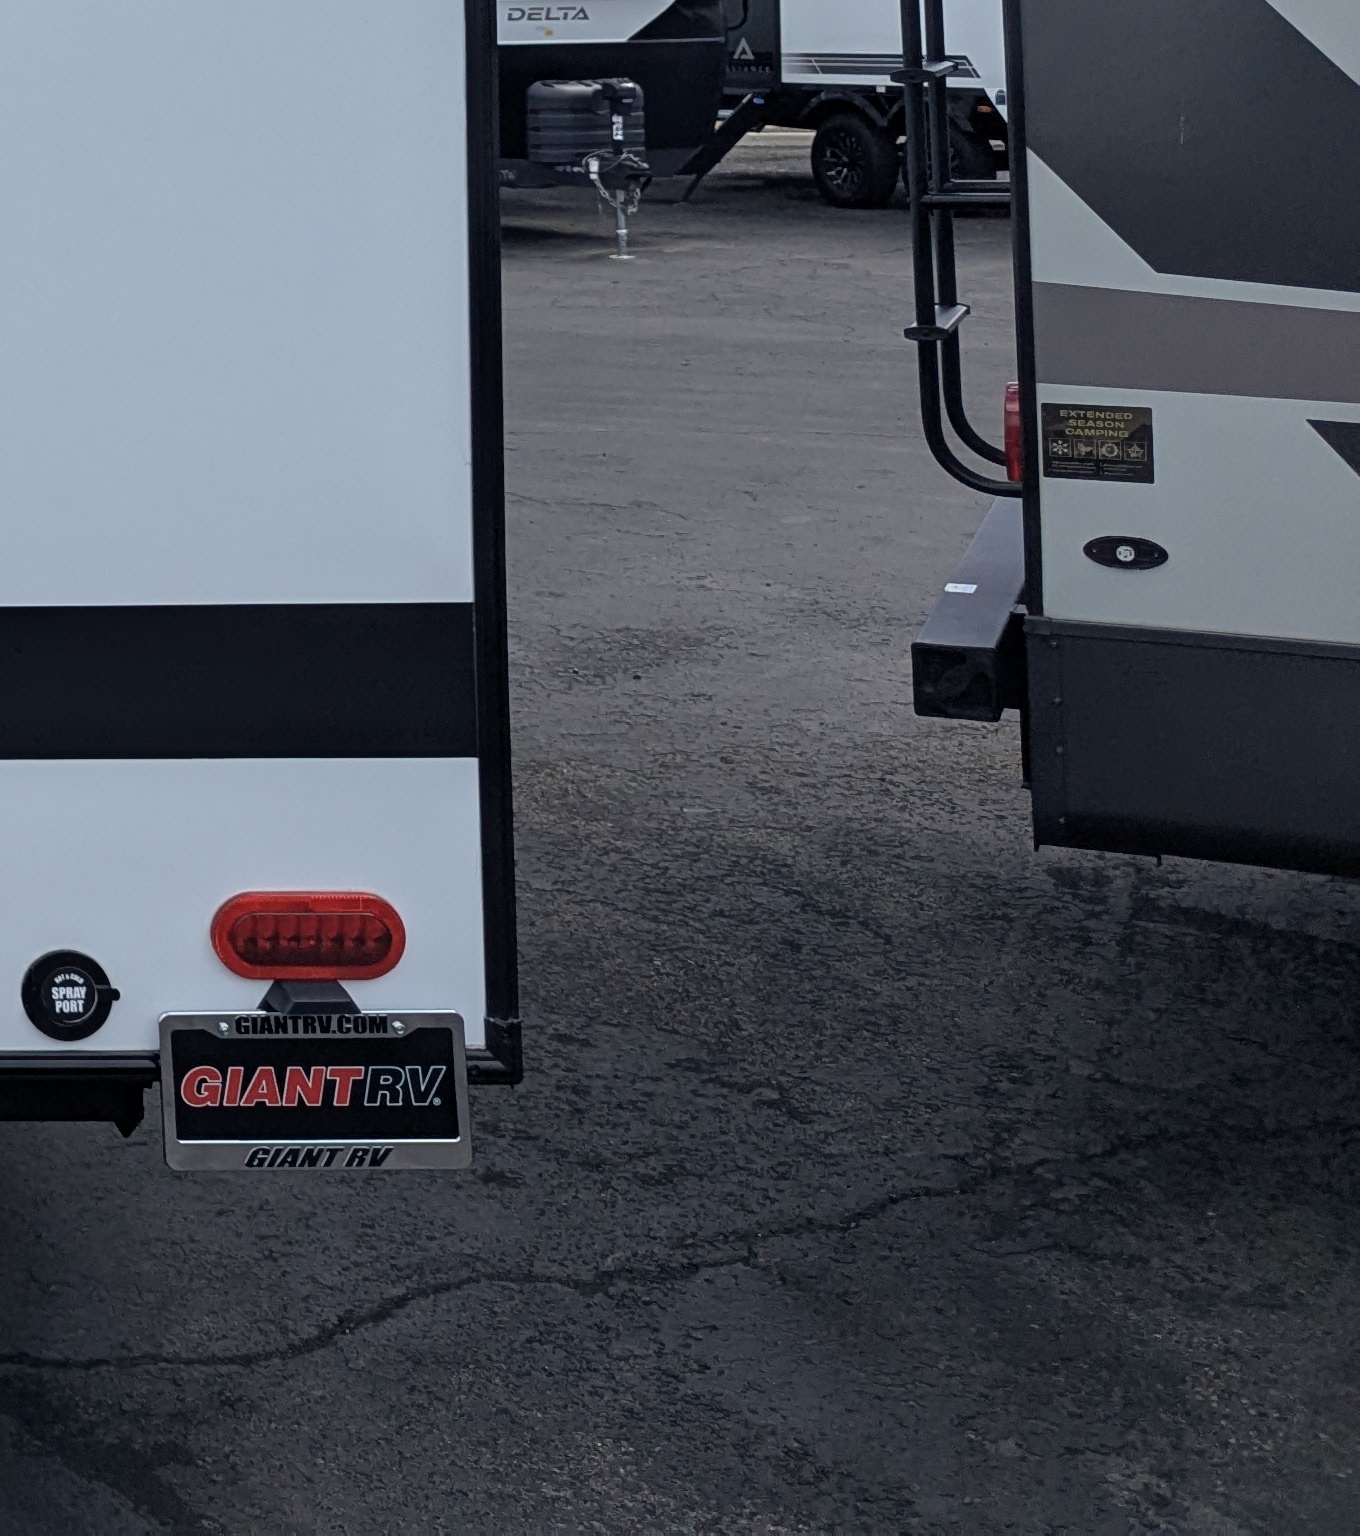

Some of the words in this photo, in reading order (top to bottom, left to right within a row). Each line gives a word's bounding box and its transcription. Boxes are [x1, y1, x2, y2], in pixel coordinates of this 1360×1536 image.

[507, 6, 590, 22] DELTA
[1060, 409, 1133, 420] EXTENDED
[1068, 419, 1125, 429] SEASON
[1065, 428, 1129, 438] CAMPING
[51, 986, 86, 999] SPRAY
[55, 1000, 84, 1014] PORT
[235, 1015, 389, 1035] GIANTRV.COM
[244, 1146, 346, 1168] GIANT
[344, 1146, 394, 1168] RV
